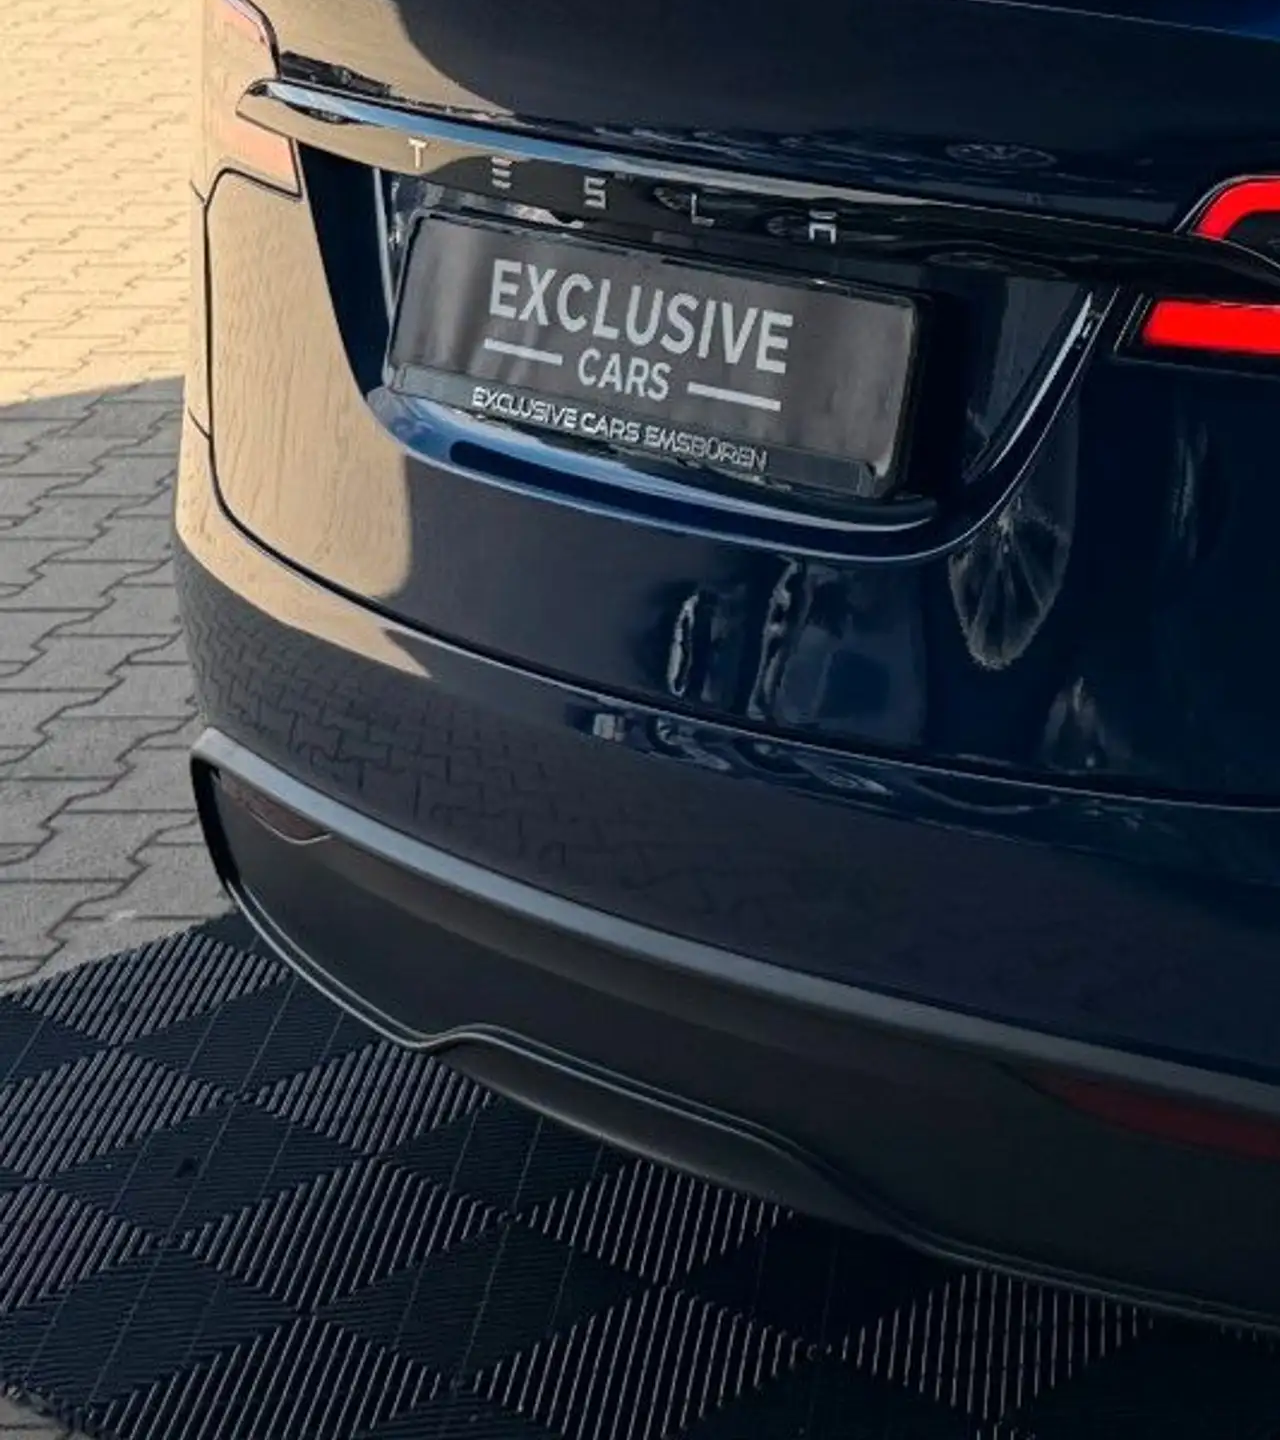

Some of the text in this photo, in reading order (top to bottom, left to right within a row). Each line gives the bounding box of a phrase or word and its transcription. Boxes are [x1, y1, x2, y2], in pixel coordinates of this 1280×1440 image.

[408, 137, 837, 245] TESLA
[489, 259, 794, 374] EXCLUSIVE
[472, 386, 577, 429] EXCLUSIVE
[580, 411, 641, 444] CARS
[577, 347, 673, 402] CARS
